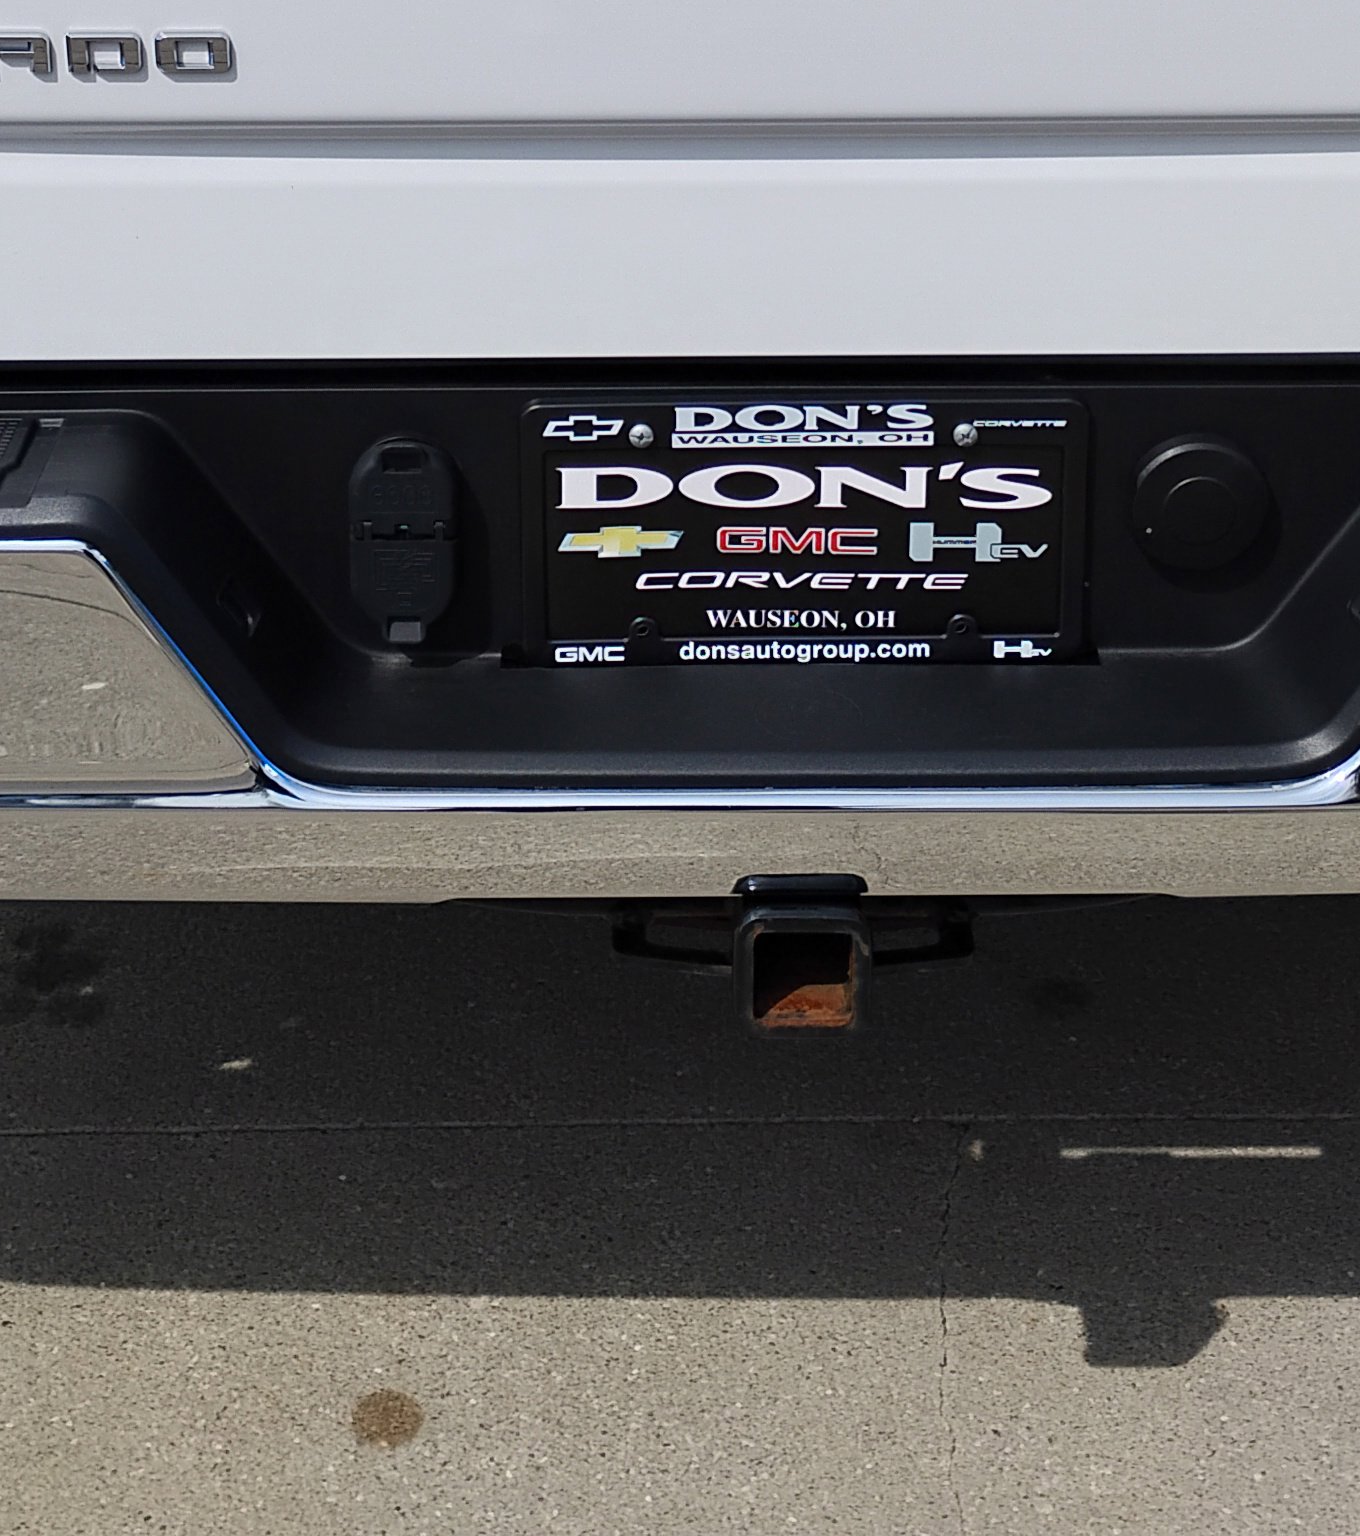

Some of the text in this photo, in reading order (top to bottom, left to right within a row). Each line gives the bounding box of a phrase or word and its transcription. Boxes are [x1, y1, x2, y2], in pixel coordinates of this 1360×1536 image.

[673, 404, 934, 432] DON'S
[972, 419, 1068, 428] CORVETTE
[677, 431, 931, 445] WAUSEON, OH
[555, 462, 1052, 510] DON'S
[716, 525, 879, 556] GMC
[635, 571, 969, 590] CORVETTE
[706, 609, 897, 632] WAUSEON, OH
[554, 646, 626, 663] GMC
[679, 639, 930, 663] donsautogroup.com
